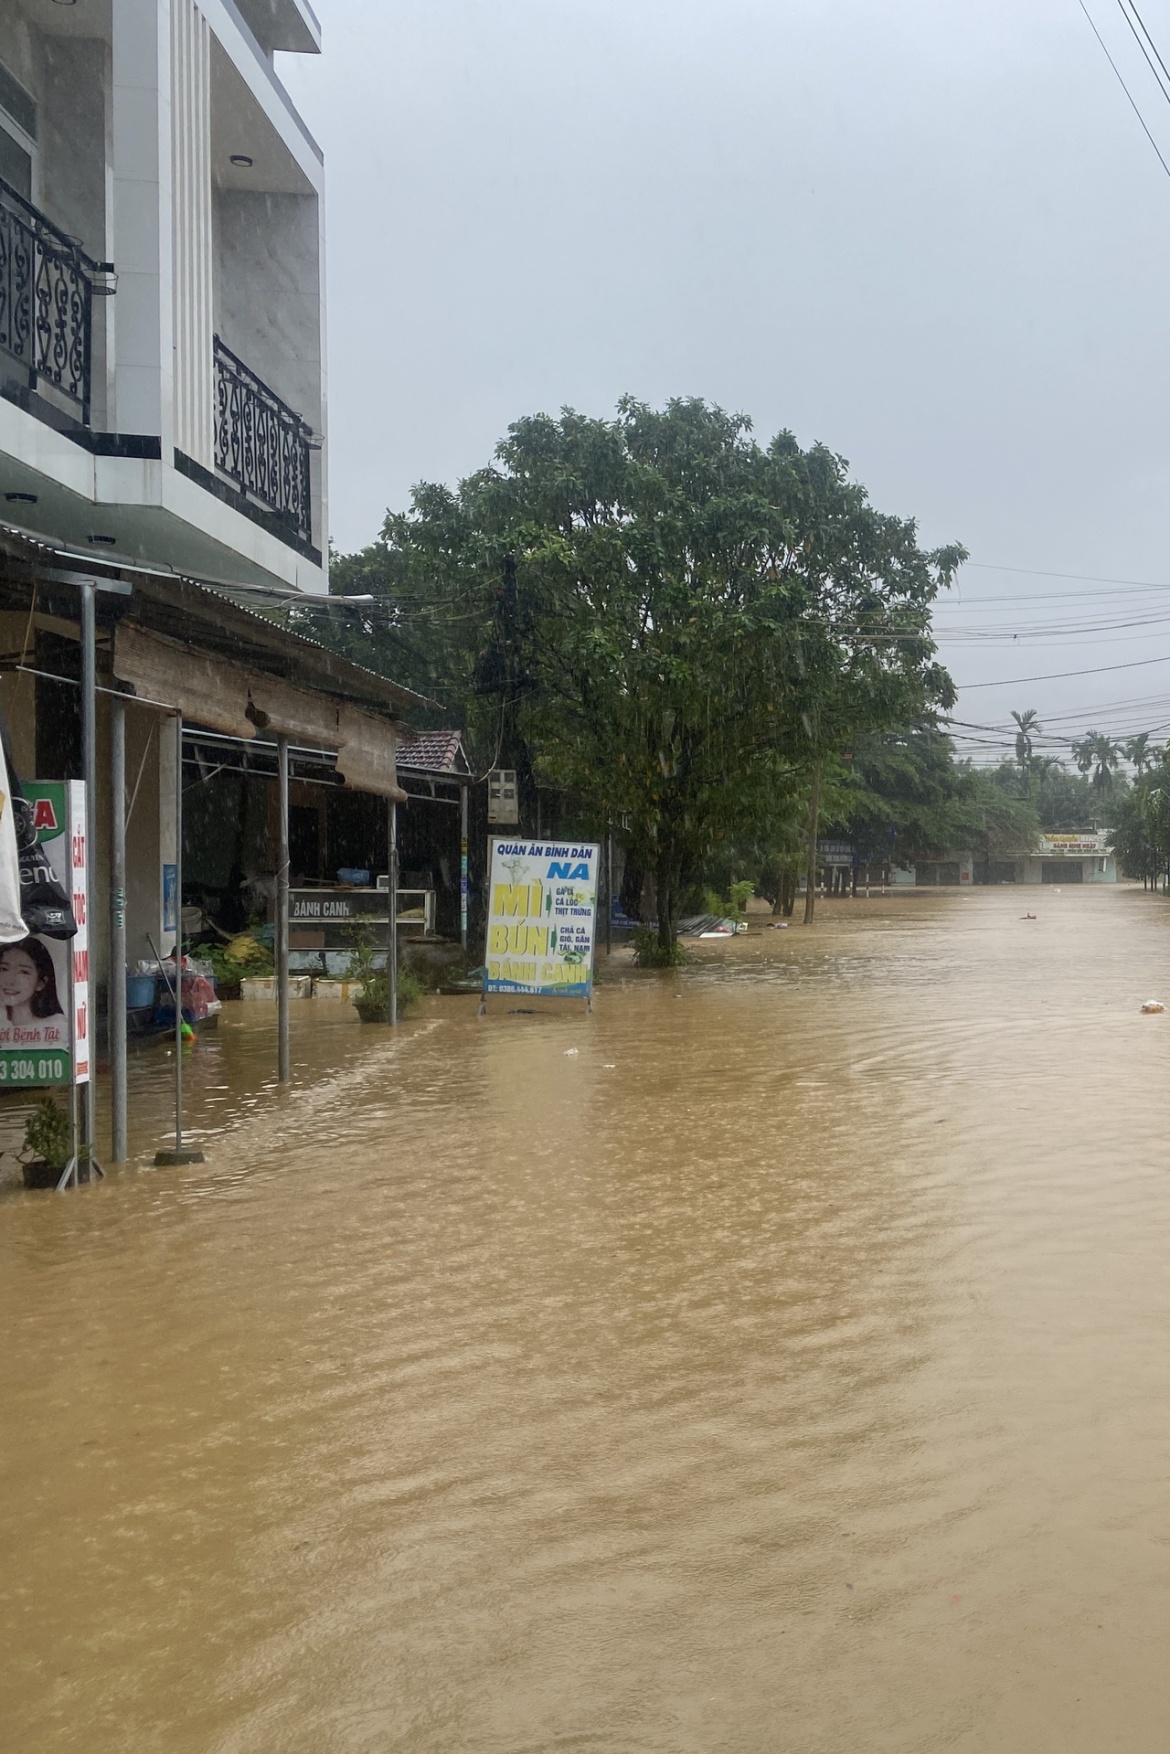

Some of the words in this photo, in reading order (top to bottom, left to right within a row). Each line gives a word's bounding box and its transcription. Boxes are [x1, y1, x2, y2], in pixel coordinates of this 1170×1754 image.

[497, 843, 526, 856] QUÁN
[528, 843, 543, 857] ĂN
[570, 845, 593, 859] DÂN
[546, 861, 590, 880] NA
[293, 899, 320, 917] BÁNH
[323, 901, 350, 917] CANH
[493, 878, 544, 918] MÌ
[489, 919, 550, 957] BÚN
[488, 958, 537, 981] BÁNH
[541, 963, 588, 983] CANH
[11, 1060, 35, 1080] 304
[38, 1059, 63, 1079] 010
